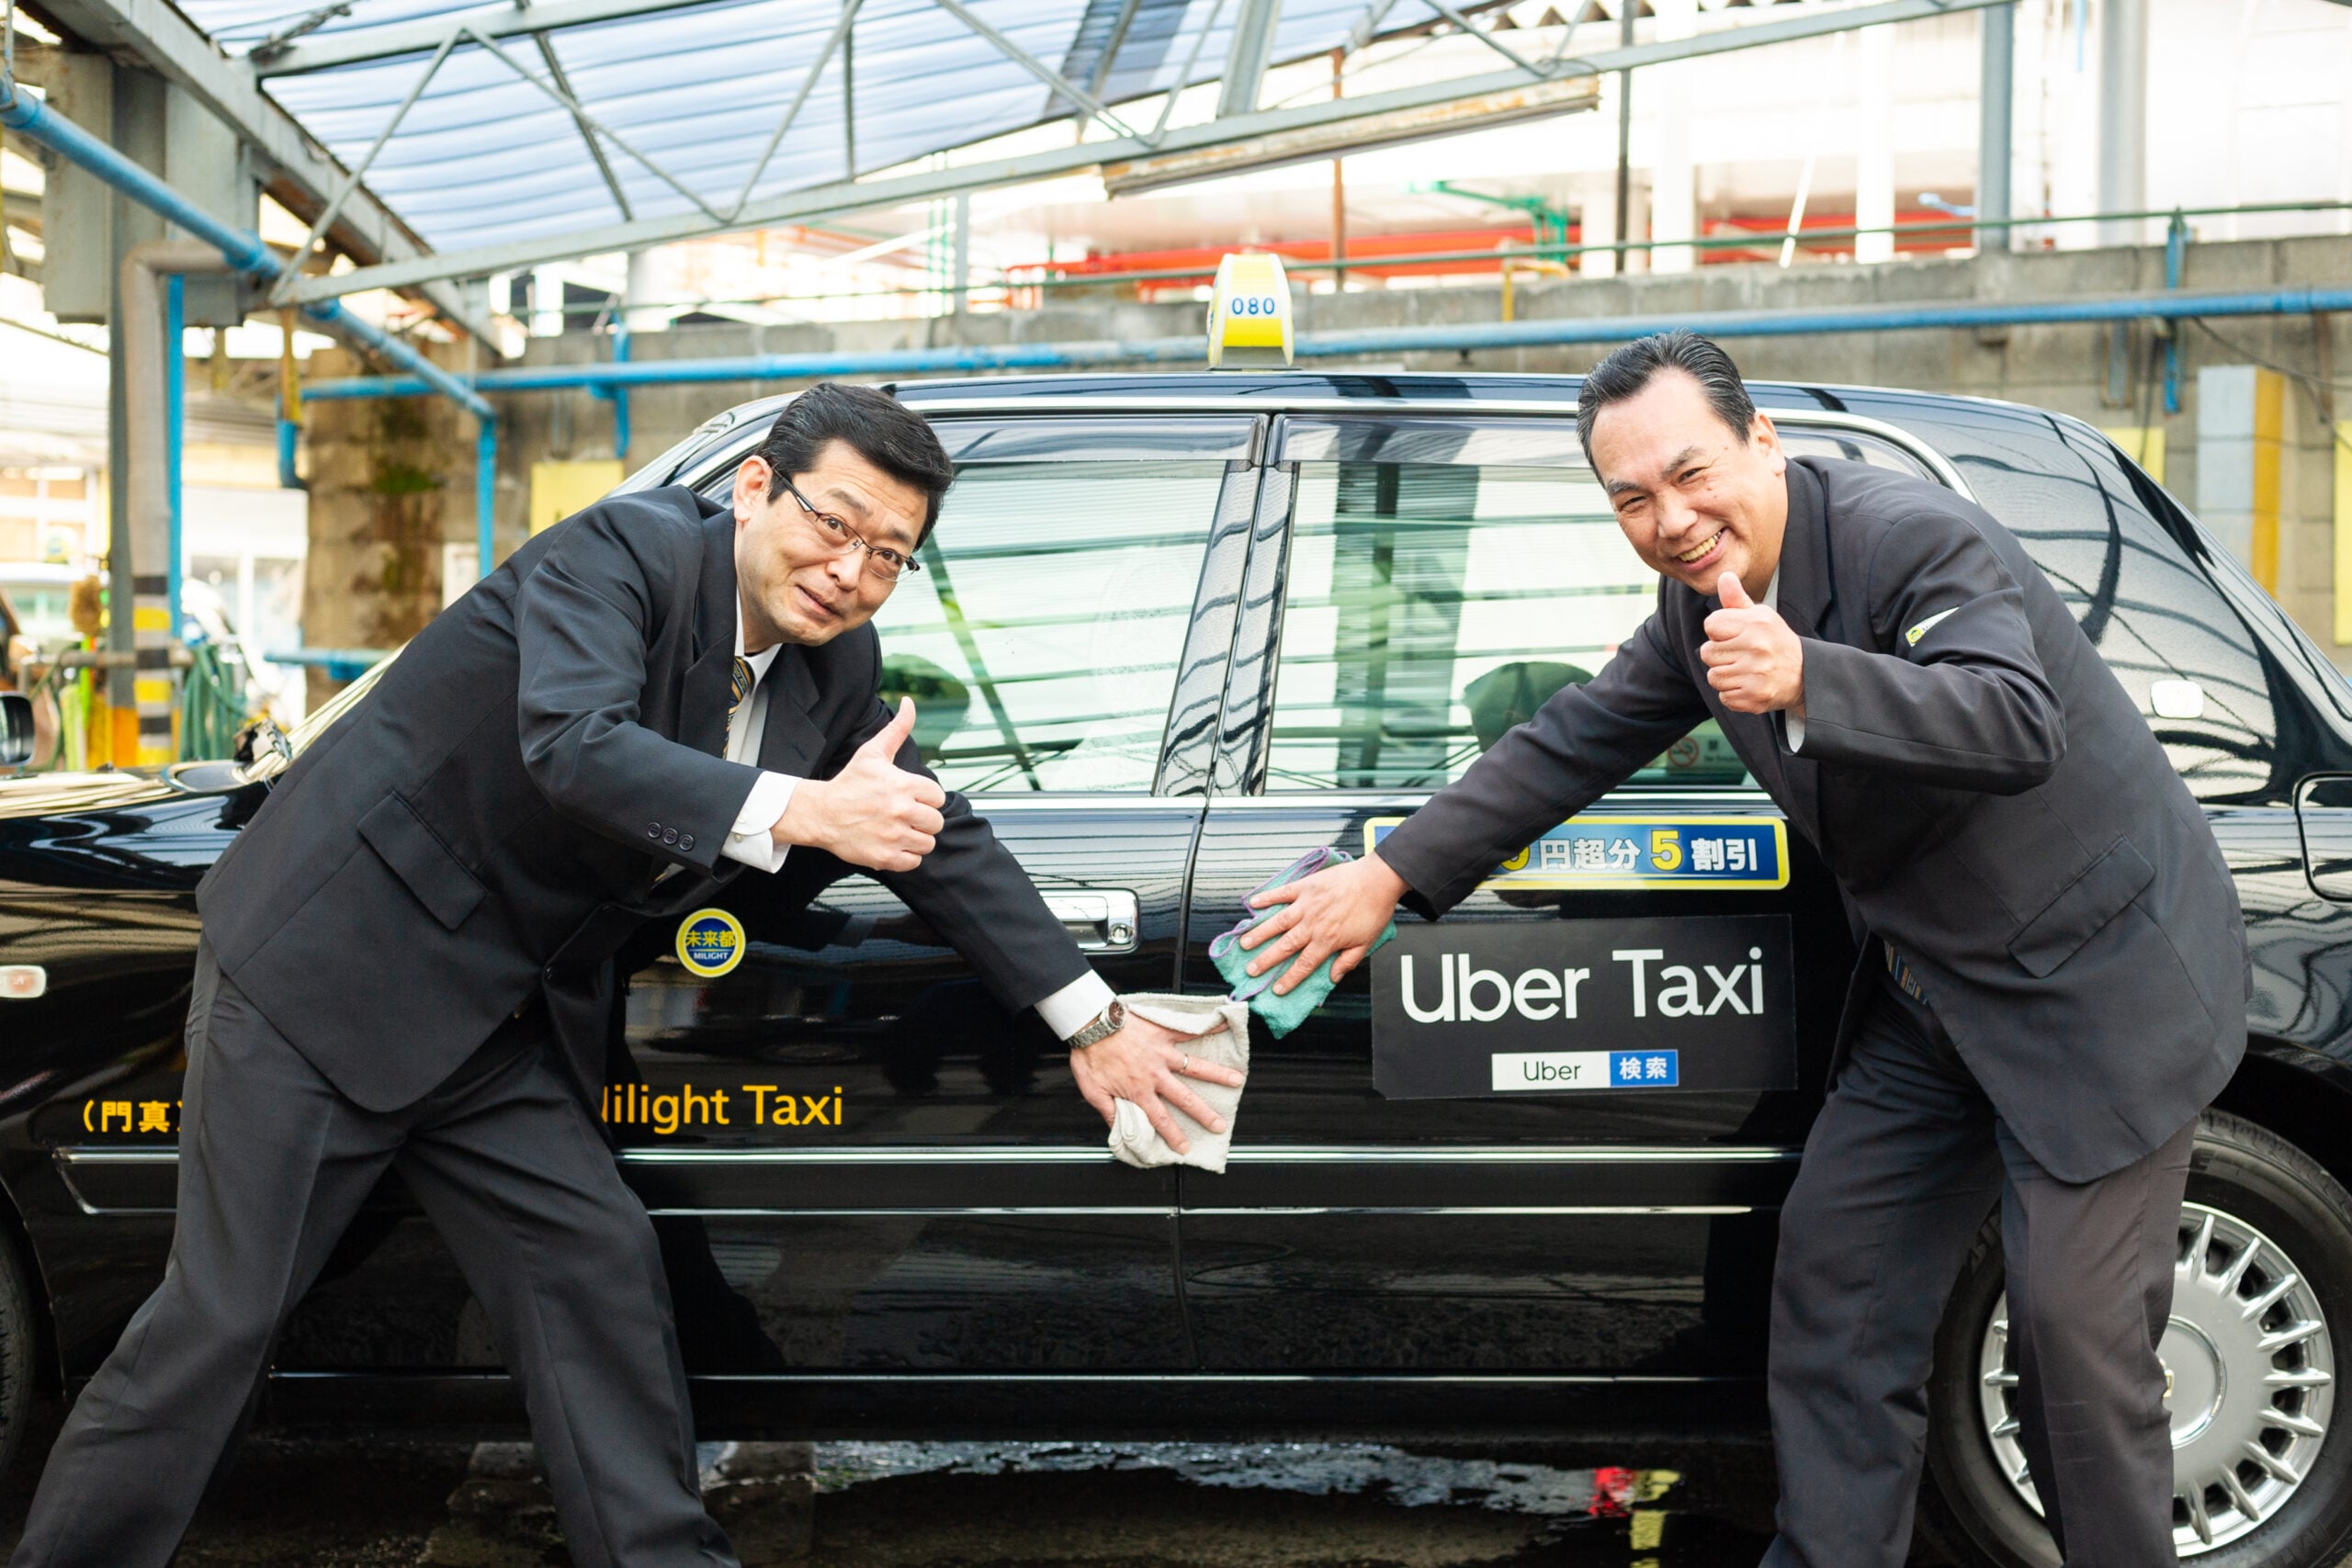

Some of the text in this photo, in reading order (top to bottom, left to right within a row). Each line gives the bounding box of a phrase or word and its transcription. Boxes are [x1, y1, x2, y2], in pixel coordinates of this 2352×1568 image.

[1231, 298, 1275, 315] 080
[685, 930, 736, 947] 未来都
[693, 952, 729, 960] MILIGHT
[1400, 946, 1764, 1023] Uber Taxi
[1523, 1056, 1668, 1081] Uber 検索
[741, 1085, 842, 1125] Taxi
